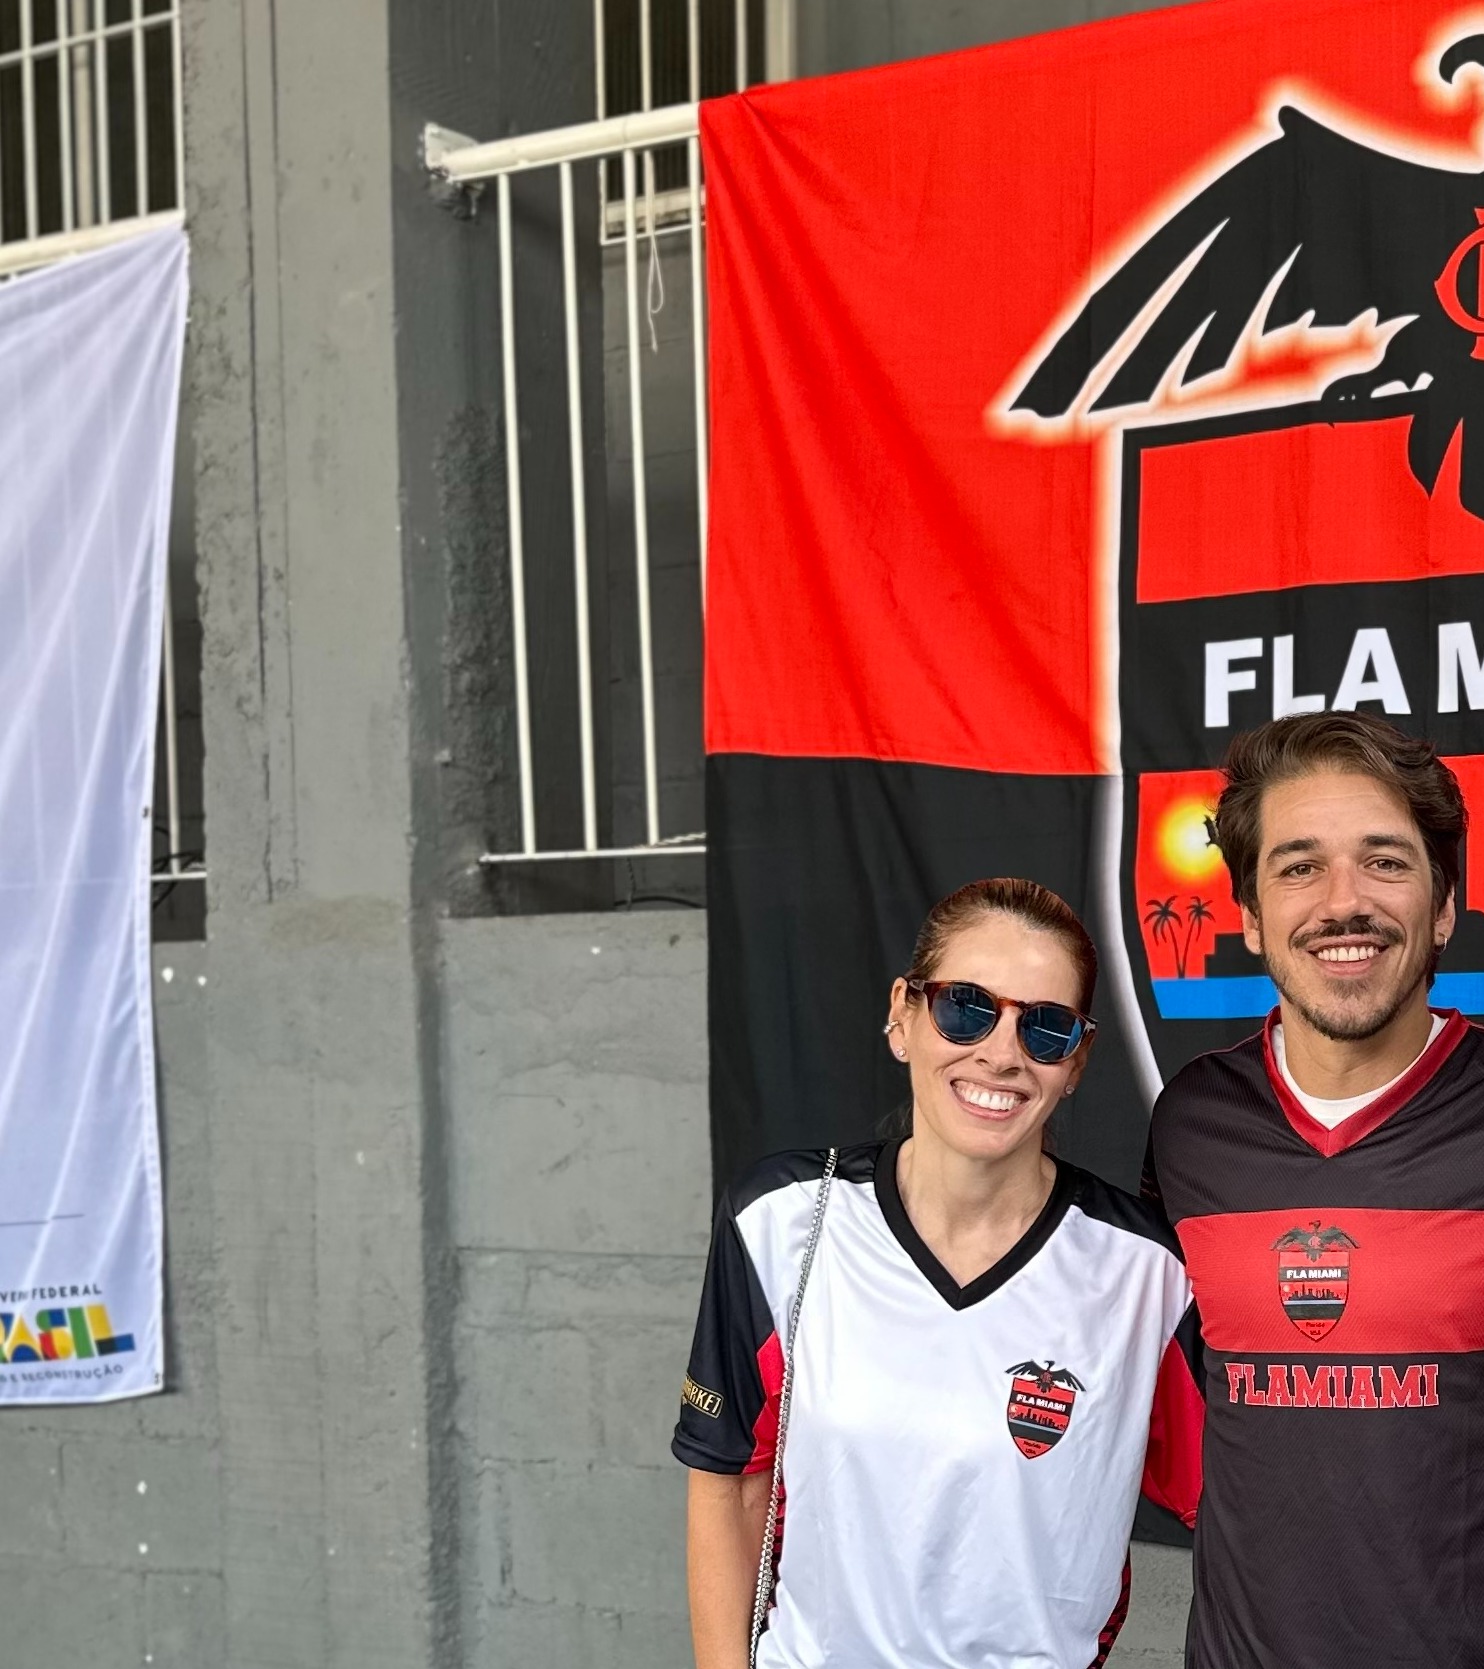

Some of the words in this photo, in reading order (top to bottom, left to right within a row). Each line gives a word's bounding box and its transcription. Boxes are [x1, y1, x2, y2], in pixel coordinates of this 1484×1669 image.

[1204, 628, 1412, 728] FLA
[1286, 1269, 1307, 1279] FLA
[1308, 1269, 1342, 1279] MIAMI
[32, 1284, 103, 1300] FEDERAL
[1225, 1362, 1440, 1409] FLAMIAMI
[1016, 1394, 1035, 1405] FLA
[1036, 1399, 1066, 1412] MIAMI
